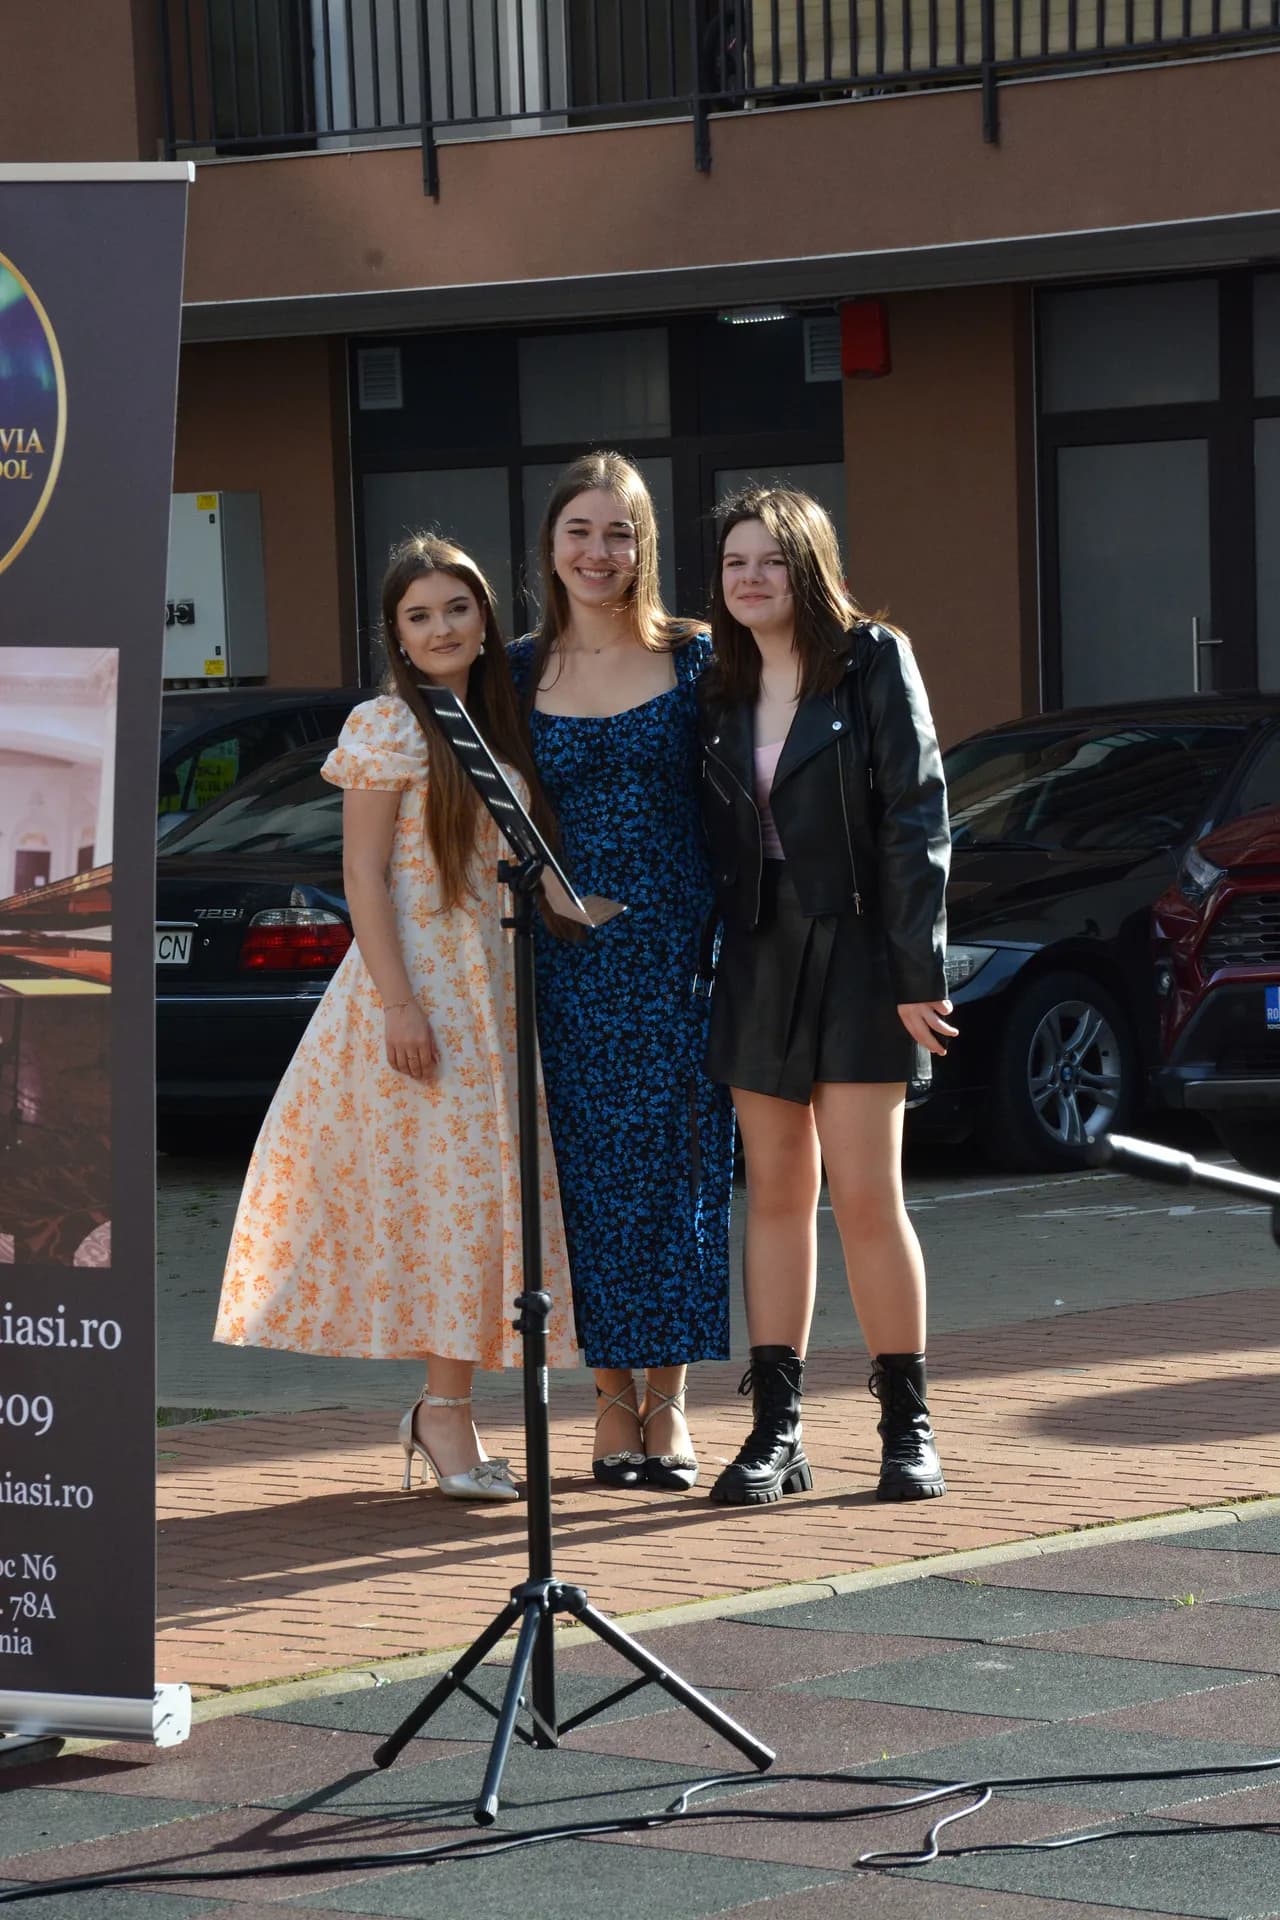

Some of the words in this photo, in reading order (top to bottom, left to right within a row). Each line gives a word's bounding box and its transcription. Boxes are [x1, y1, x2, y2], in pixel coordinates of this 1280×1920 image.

[0, 428, 44, 453] VIA
[0, 460, 32, 479] OL
[194, 908, 244, 918] 728i
[159, 935, 187, 960] CN
[0, 1301, 122, 1350] iasi.ro
[0, 1394, 54, 1436] 09
[0, 1471, 94, 1509] iasi.ro
[0, 1559, 17, 1578] c
[21, 1553, 57, 1581] N6
[10, 1591, 57, 1621] 78A
[0, 1627, 33, 1655] nia
